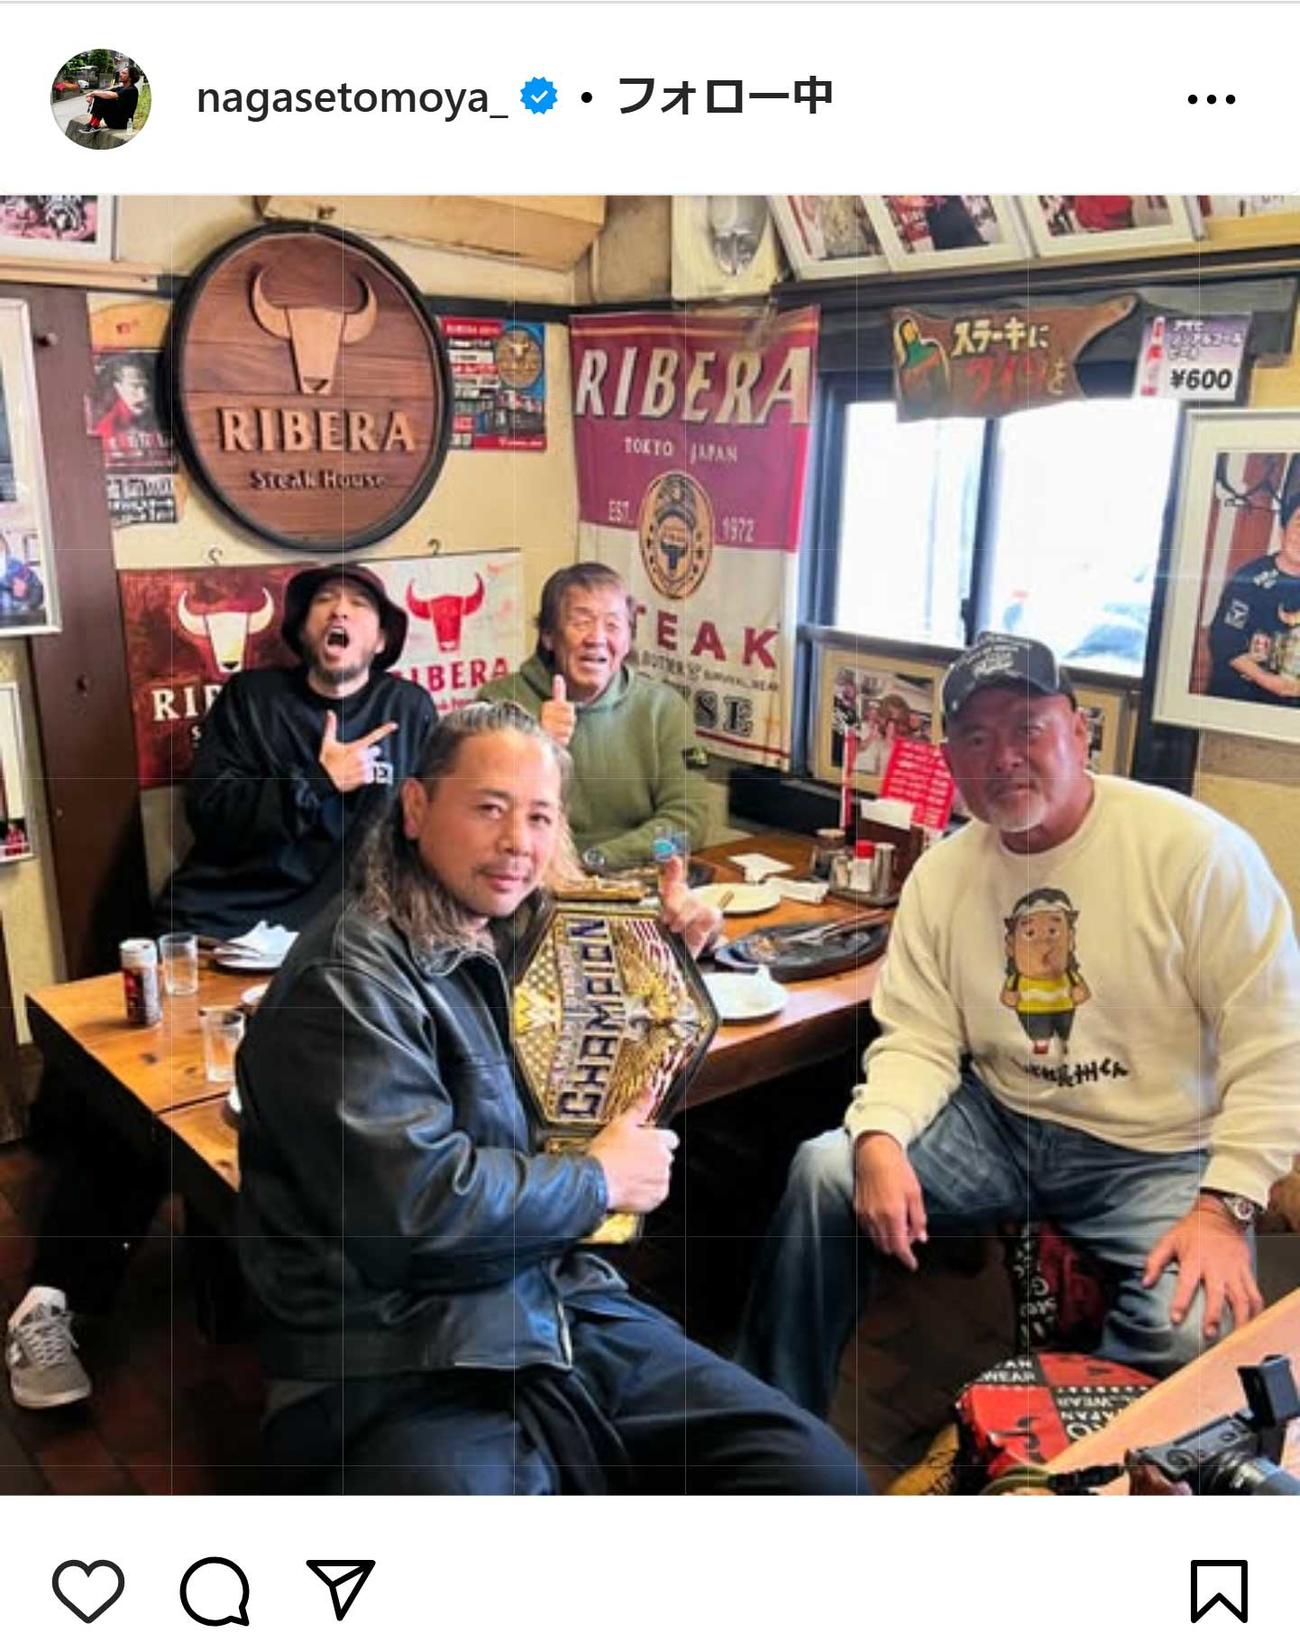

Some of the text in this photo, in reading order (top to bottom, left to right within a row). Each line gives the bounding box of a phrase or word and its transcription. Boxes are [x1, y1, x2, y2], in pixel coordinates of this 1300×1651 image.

[574, 346, 812, 426] RIBERA
[1169, 368, 1233, 391] ¥600
[219, 408, 416, 452] RIBERA
[624, 436, 738, 464] TOKYO JAPAN
[250, 470, 387, 489] Steak House
[721, 516, 755, 543] 1972
[394, 656, 508, 691] IBERA
[556, 918, 627, 1120] CHAMPION
